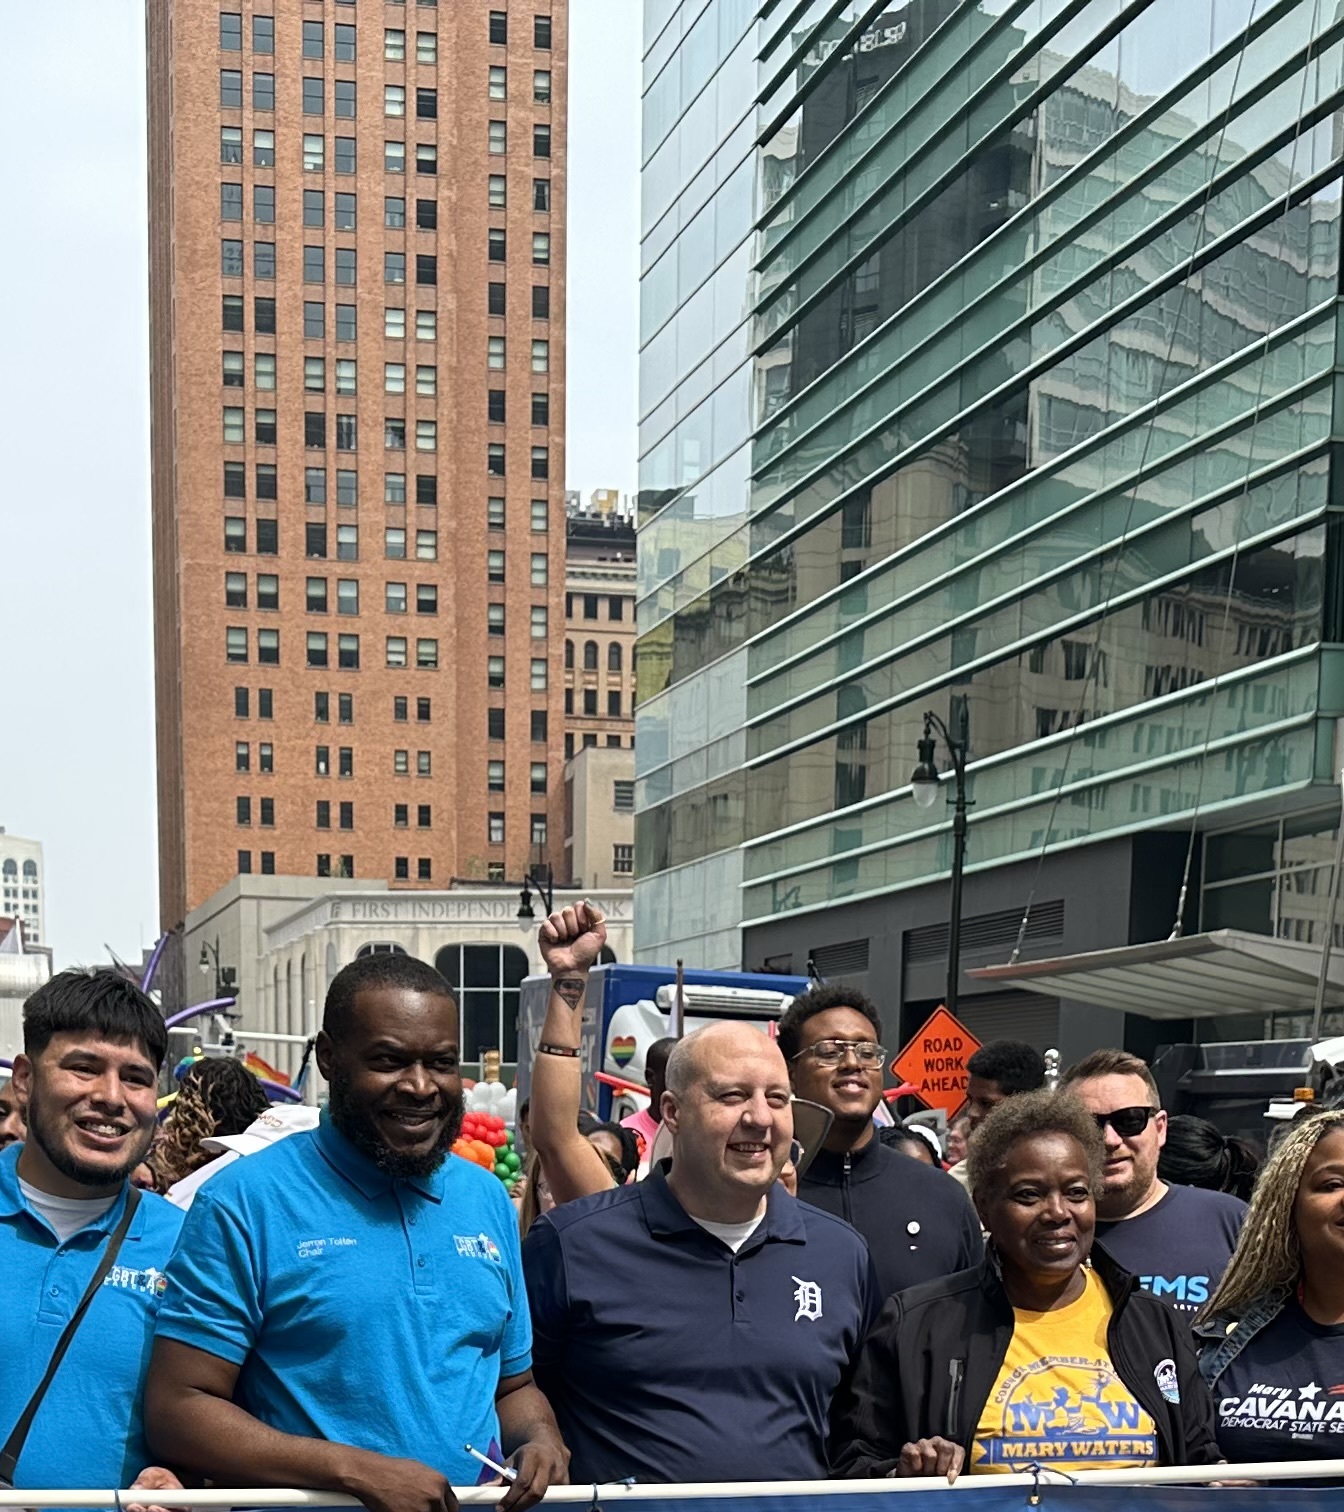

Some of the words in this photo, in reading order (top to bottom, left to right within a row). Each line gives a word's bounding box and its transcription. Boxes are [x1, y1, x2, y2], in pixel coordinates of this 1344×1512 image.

[351, 901, 401, 918] FIRST
[923, 1037, 963, 1053] ROAD
[924, 1056, 964, 1073] WORK
[920, 1075, 969, 1093] AHEAD
[1247, 1383, 1293, 1400] Mary
[1220, 1416, 1288, 1431] DEMOCRAT
[1288, 1420, 1327, 1433] STATE
[1001, 1441, 1070, 1458] MARY
[1070, 1440, 1154, 1457] WATERS
